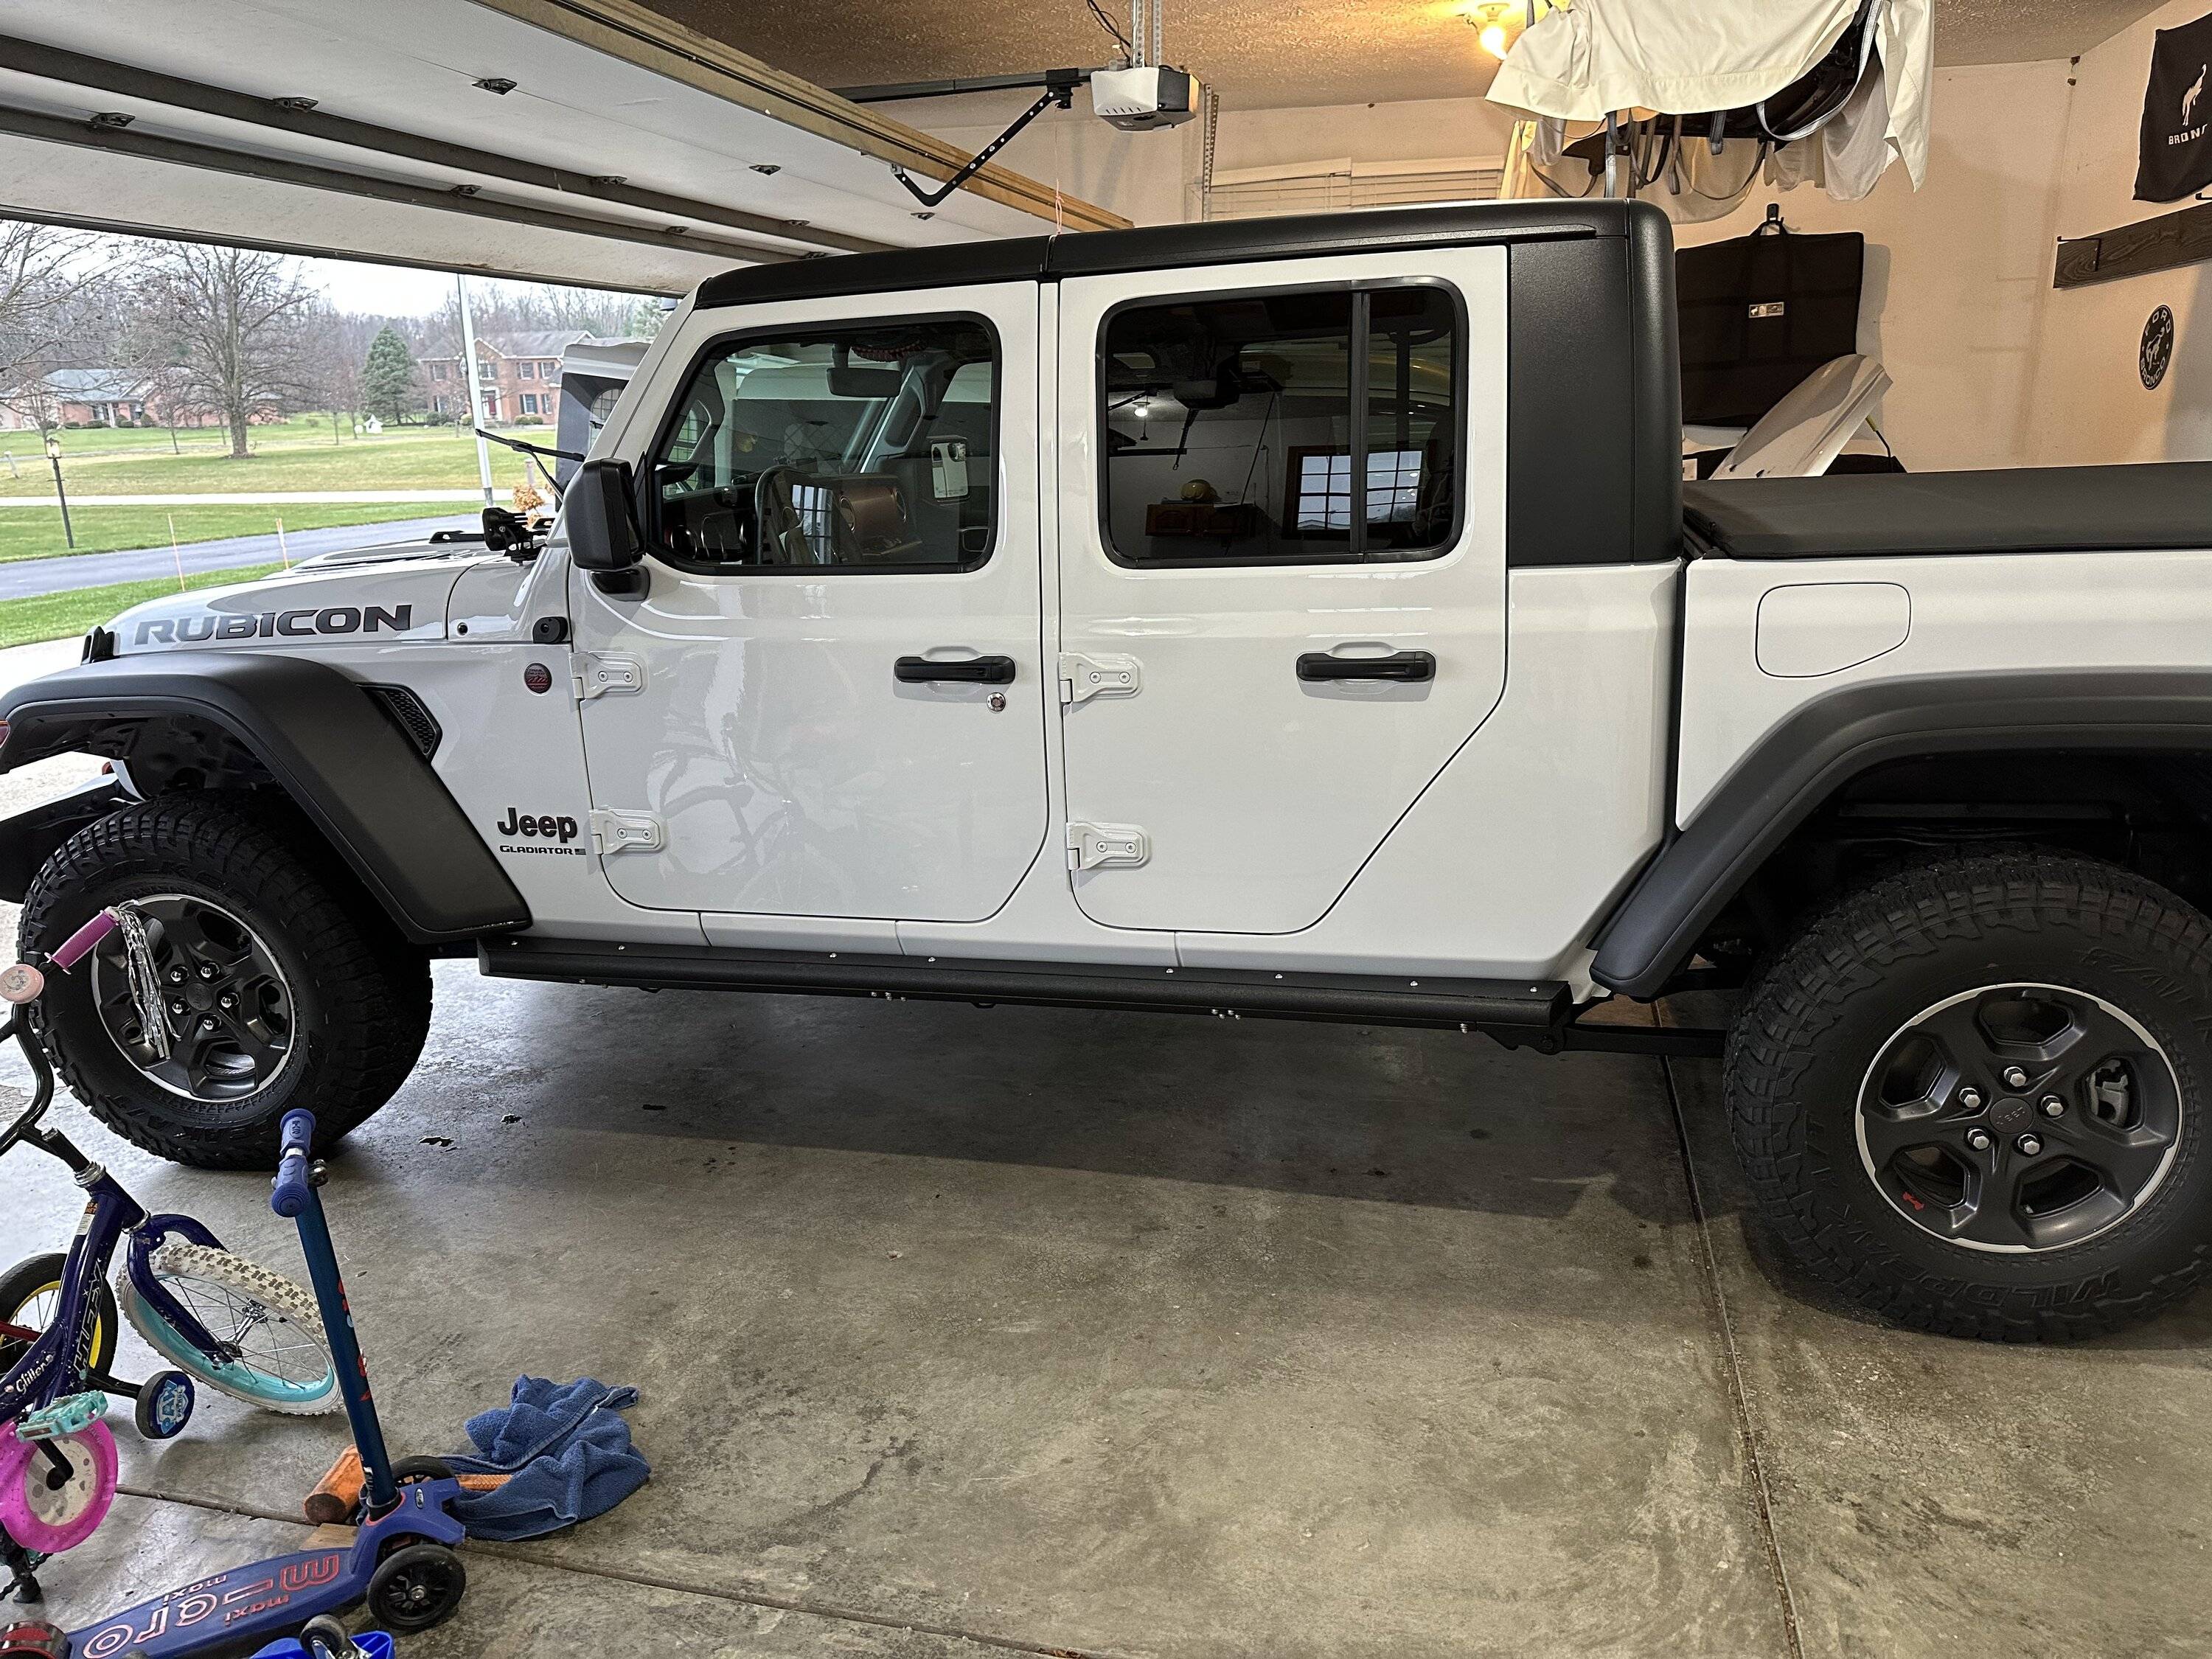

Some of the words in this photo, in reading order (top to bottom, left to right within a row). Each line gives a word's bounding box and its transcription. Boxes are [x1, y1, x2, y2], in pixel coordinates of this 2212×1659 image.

[2140, 356, 2166, 386] BRONCO
[134, 604, 412, 645] RUBICON
[497, 807, 577, 844] Jeep
[499, 845, 574, 855] GLADIATOR
[160, 1380, 178, 1434] PAW
[162, 1574, 228, 1605] maxi
[224, 1594, 290, 1628] maxi
